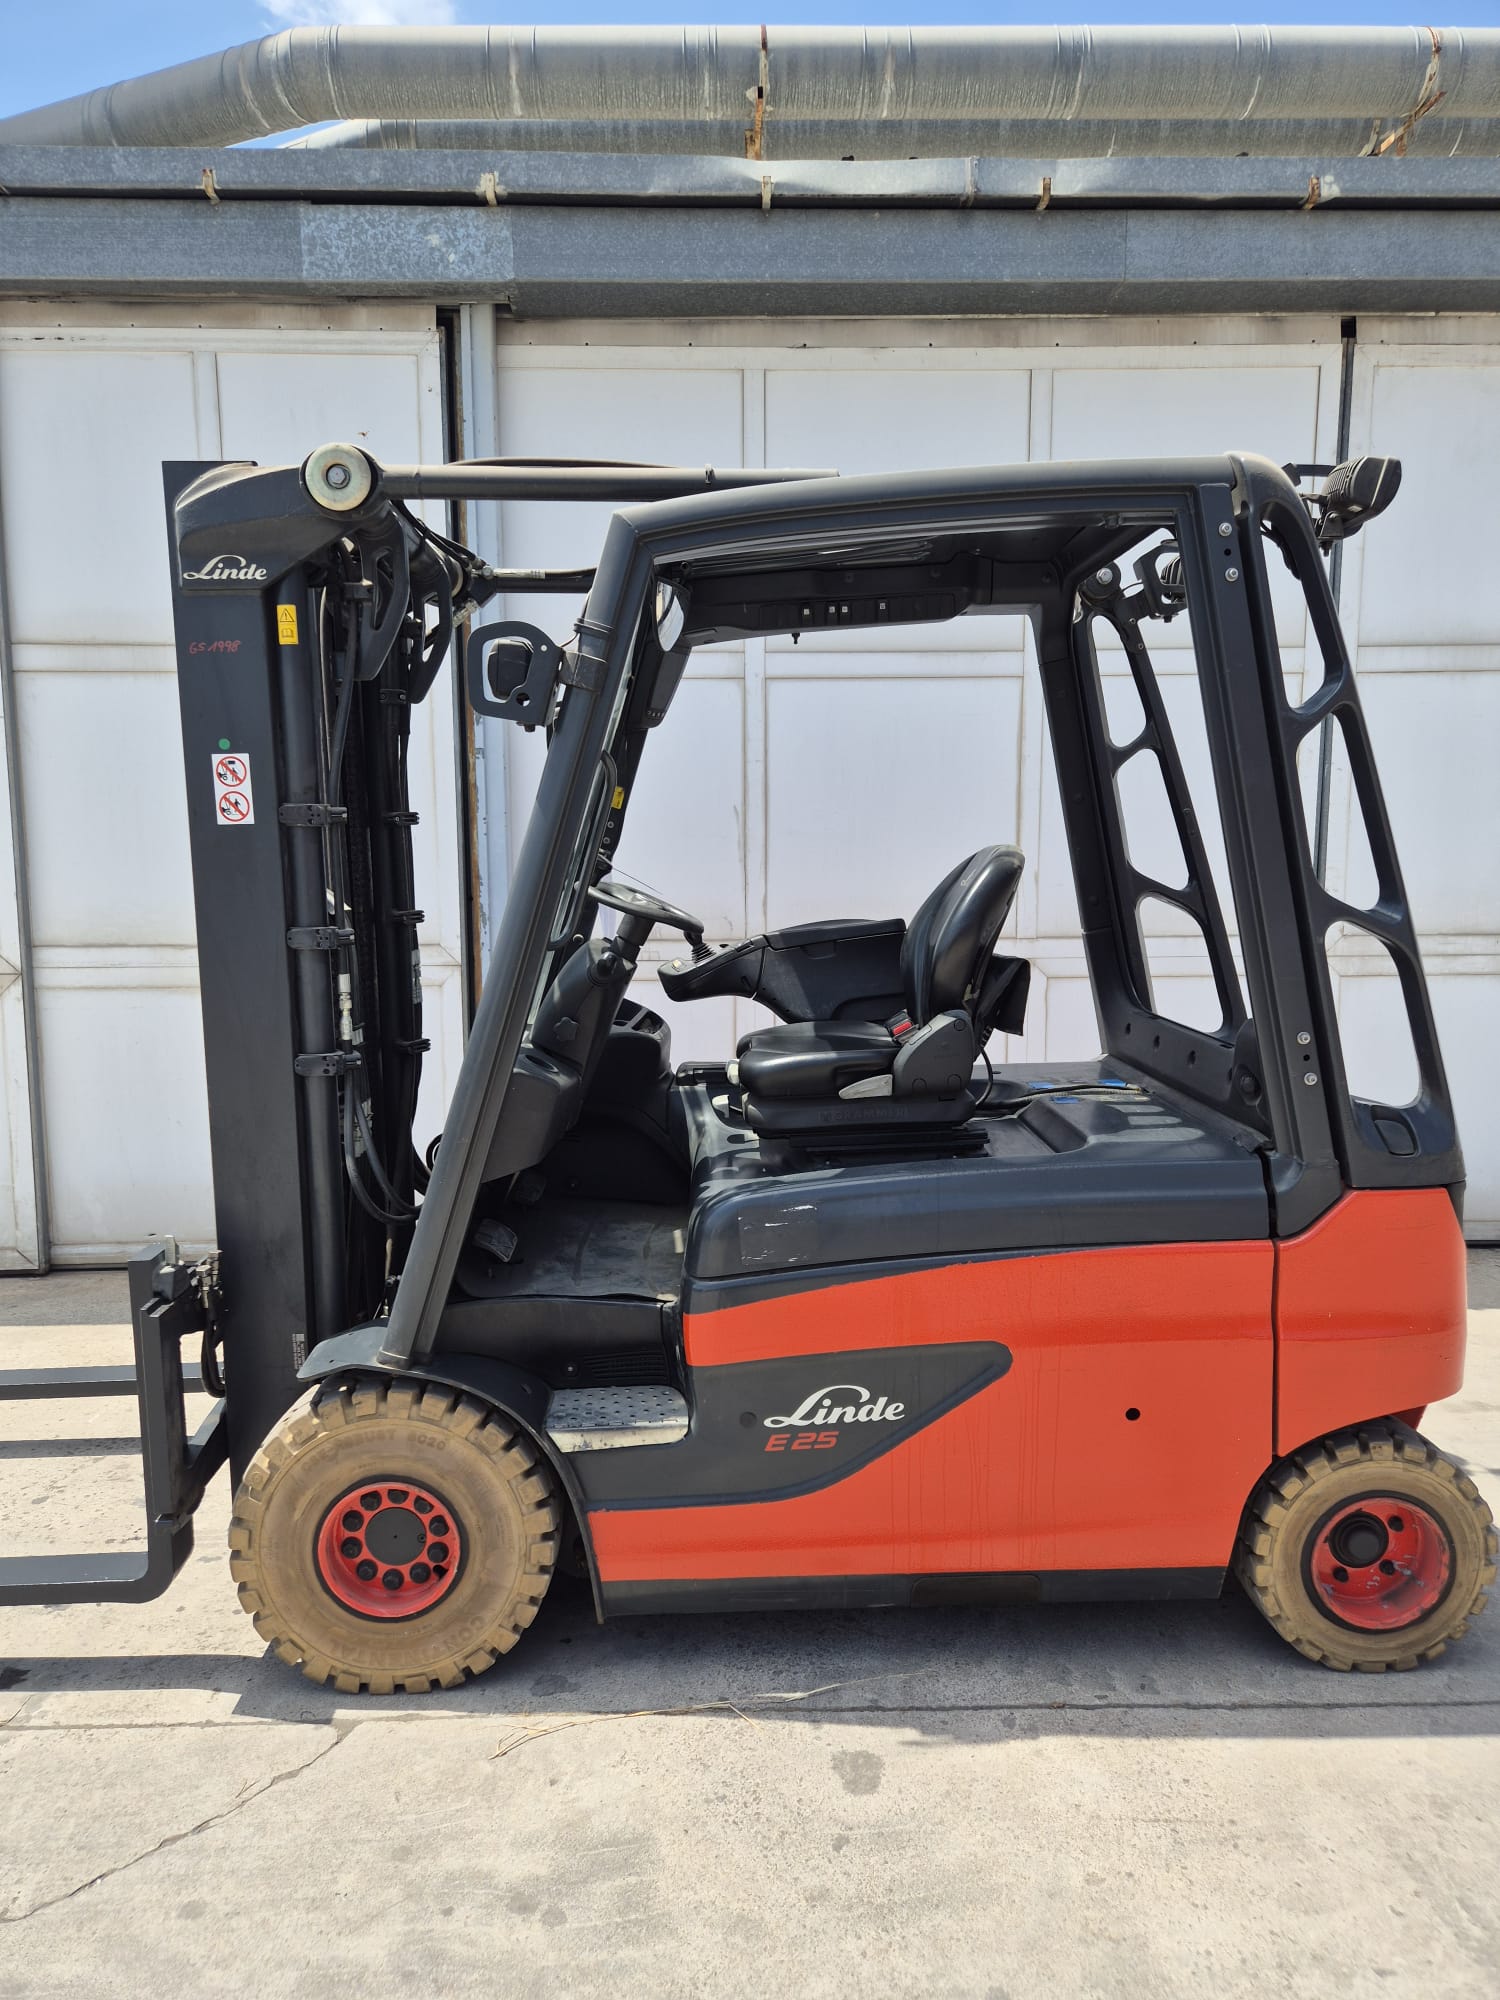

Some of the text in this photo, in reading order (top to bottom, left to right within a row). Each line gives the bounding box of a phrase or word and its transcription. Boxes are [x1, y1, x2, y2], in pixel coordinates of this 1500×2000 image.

[183, 554, 267, 580] Linde
[763, 1384, 905, 1428] Linde
[764, 1430, 840, 1451] E 25
[332, 1614, 485, 1668] CONNENTAL
